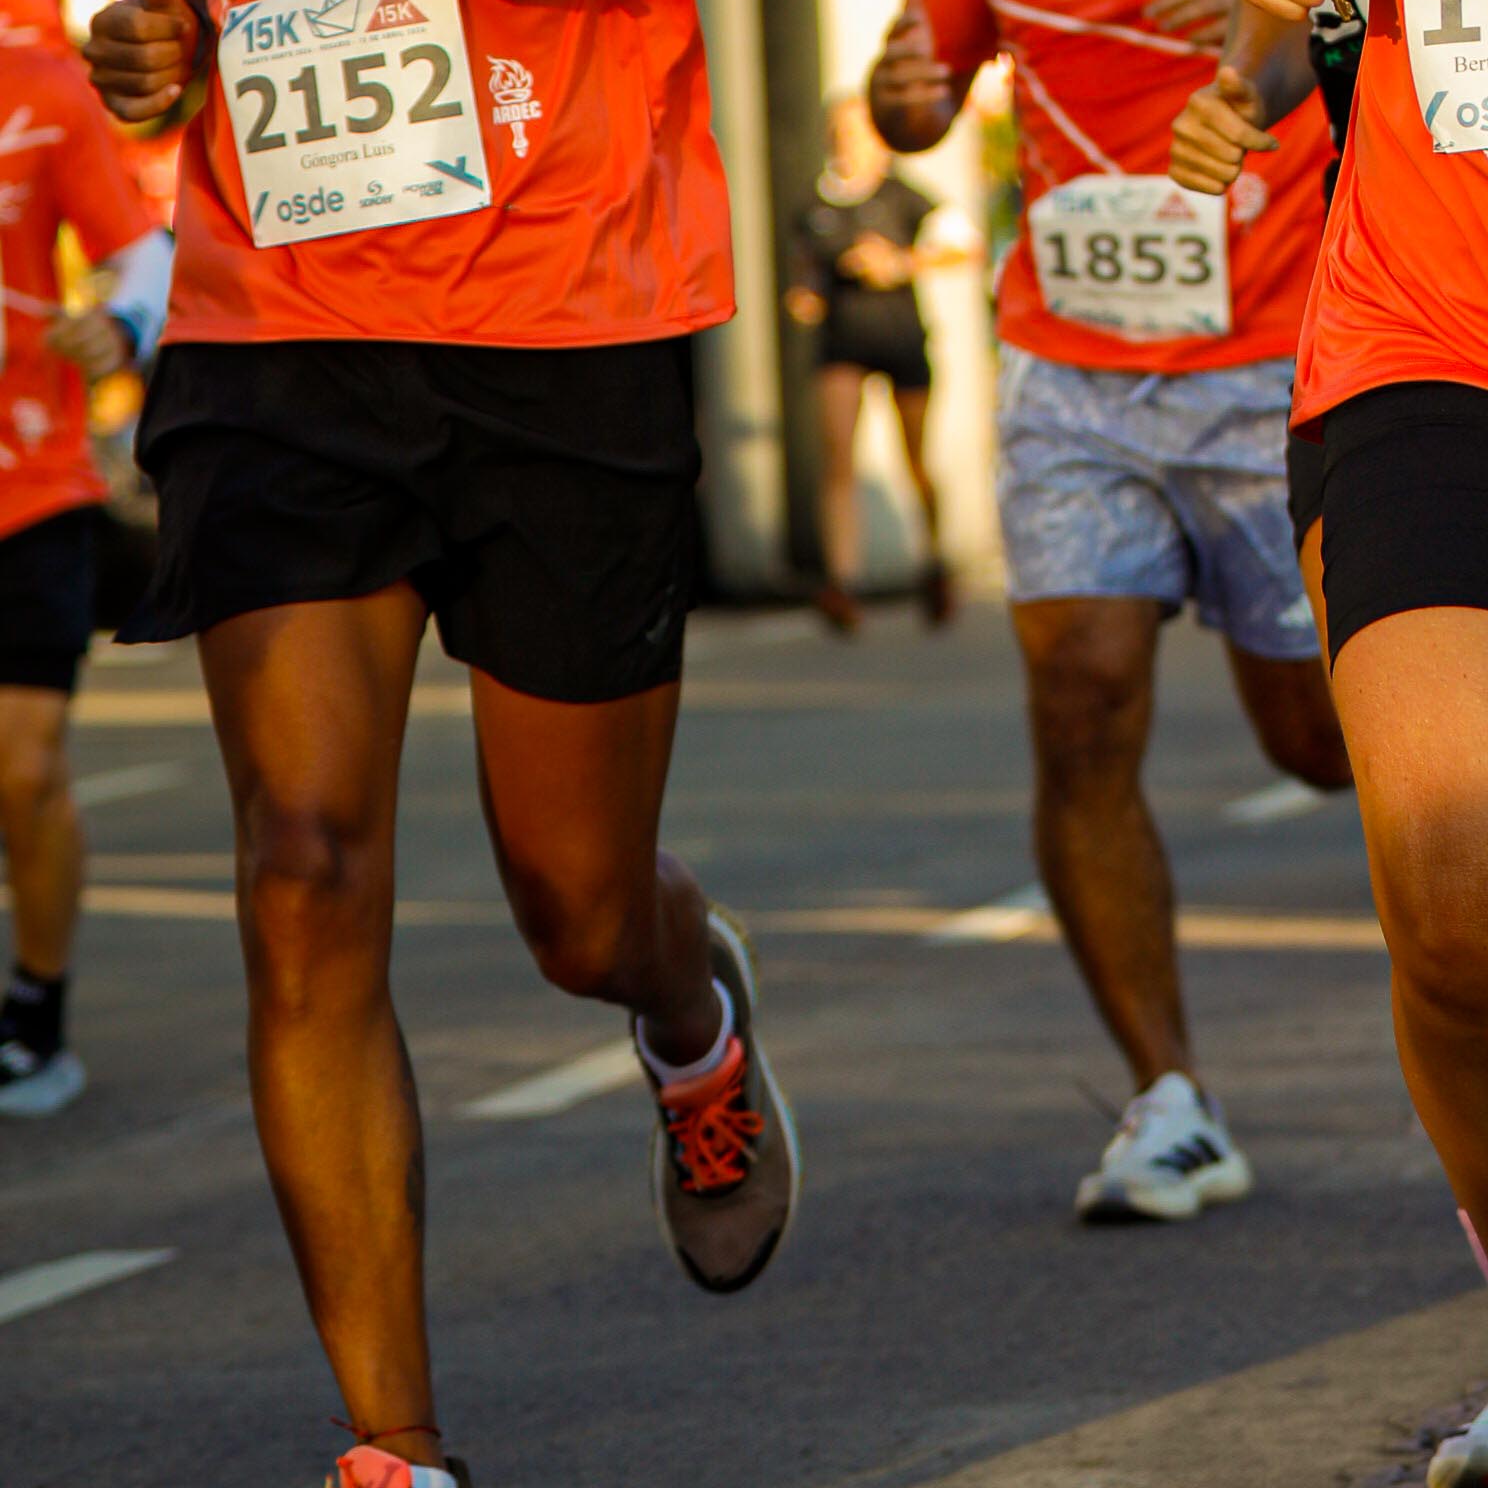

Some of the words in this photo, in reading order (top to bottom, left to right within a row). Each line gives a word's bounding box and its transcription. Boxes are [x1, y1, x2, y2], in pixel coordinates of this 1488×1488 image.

[241, 11, 300, 53] 15K
[375, 2, 414, 25] 15K
[235, 42, 463, 154] 2152
[362, 142, 395, 160] Luis
[277, 186, 345, 224] osde
[1045, 231, 1211, 285] 1853
